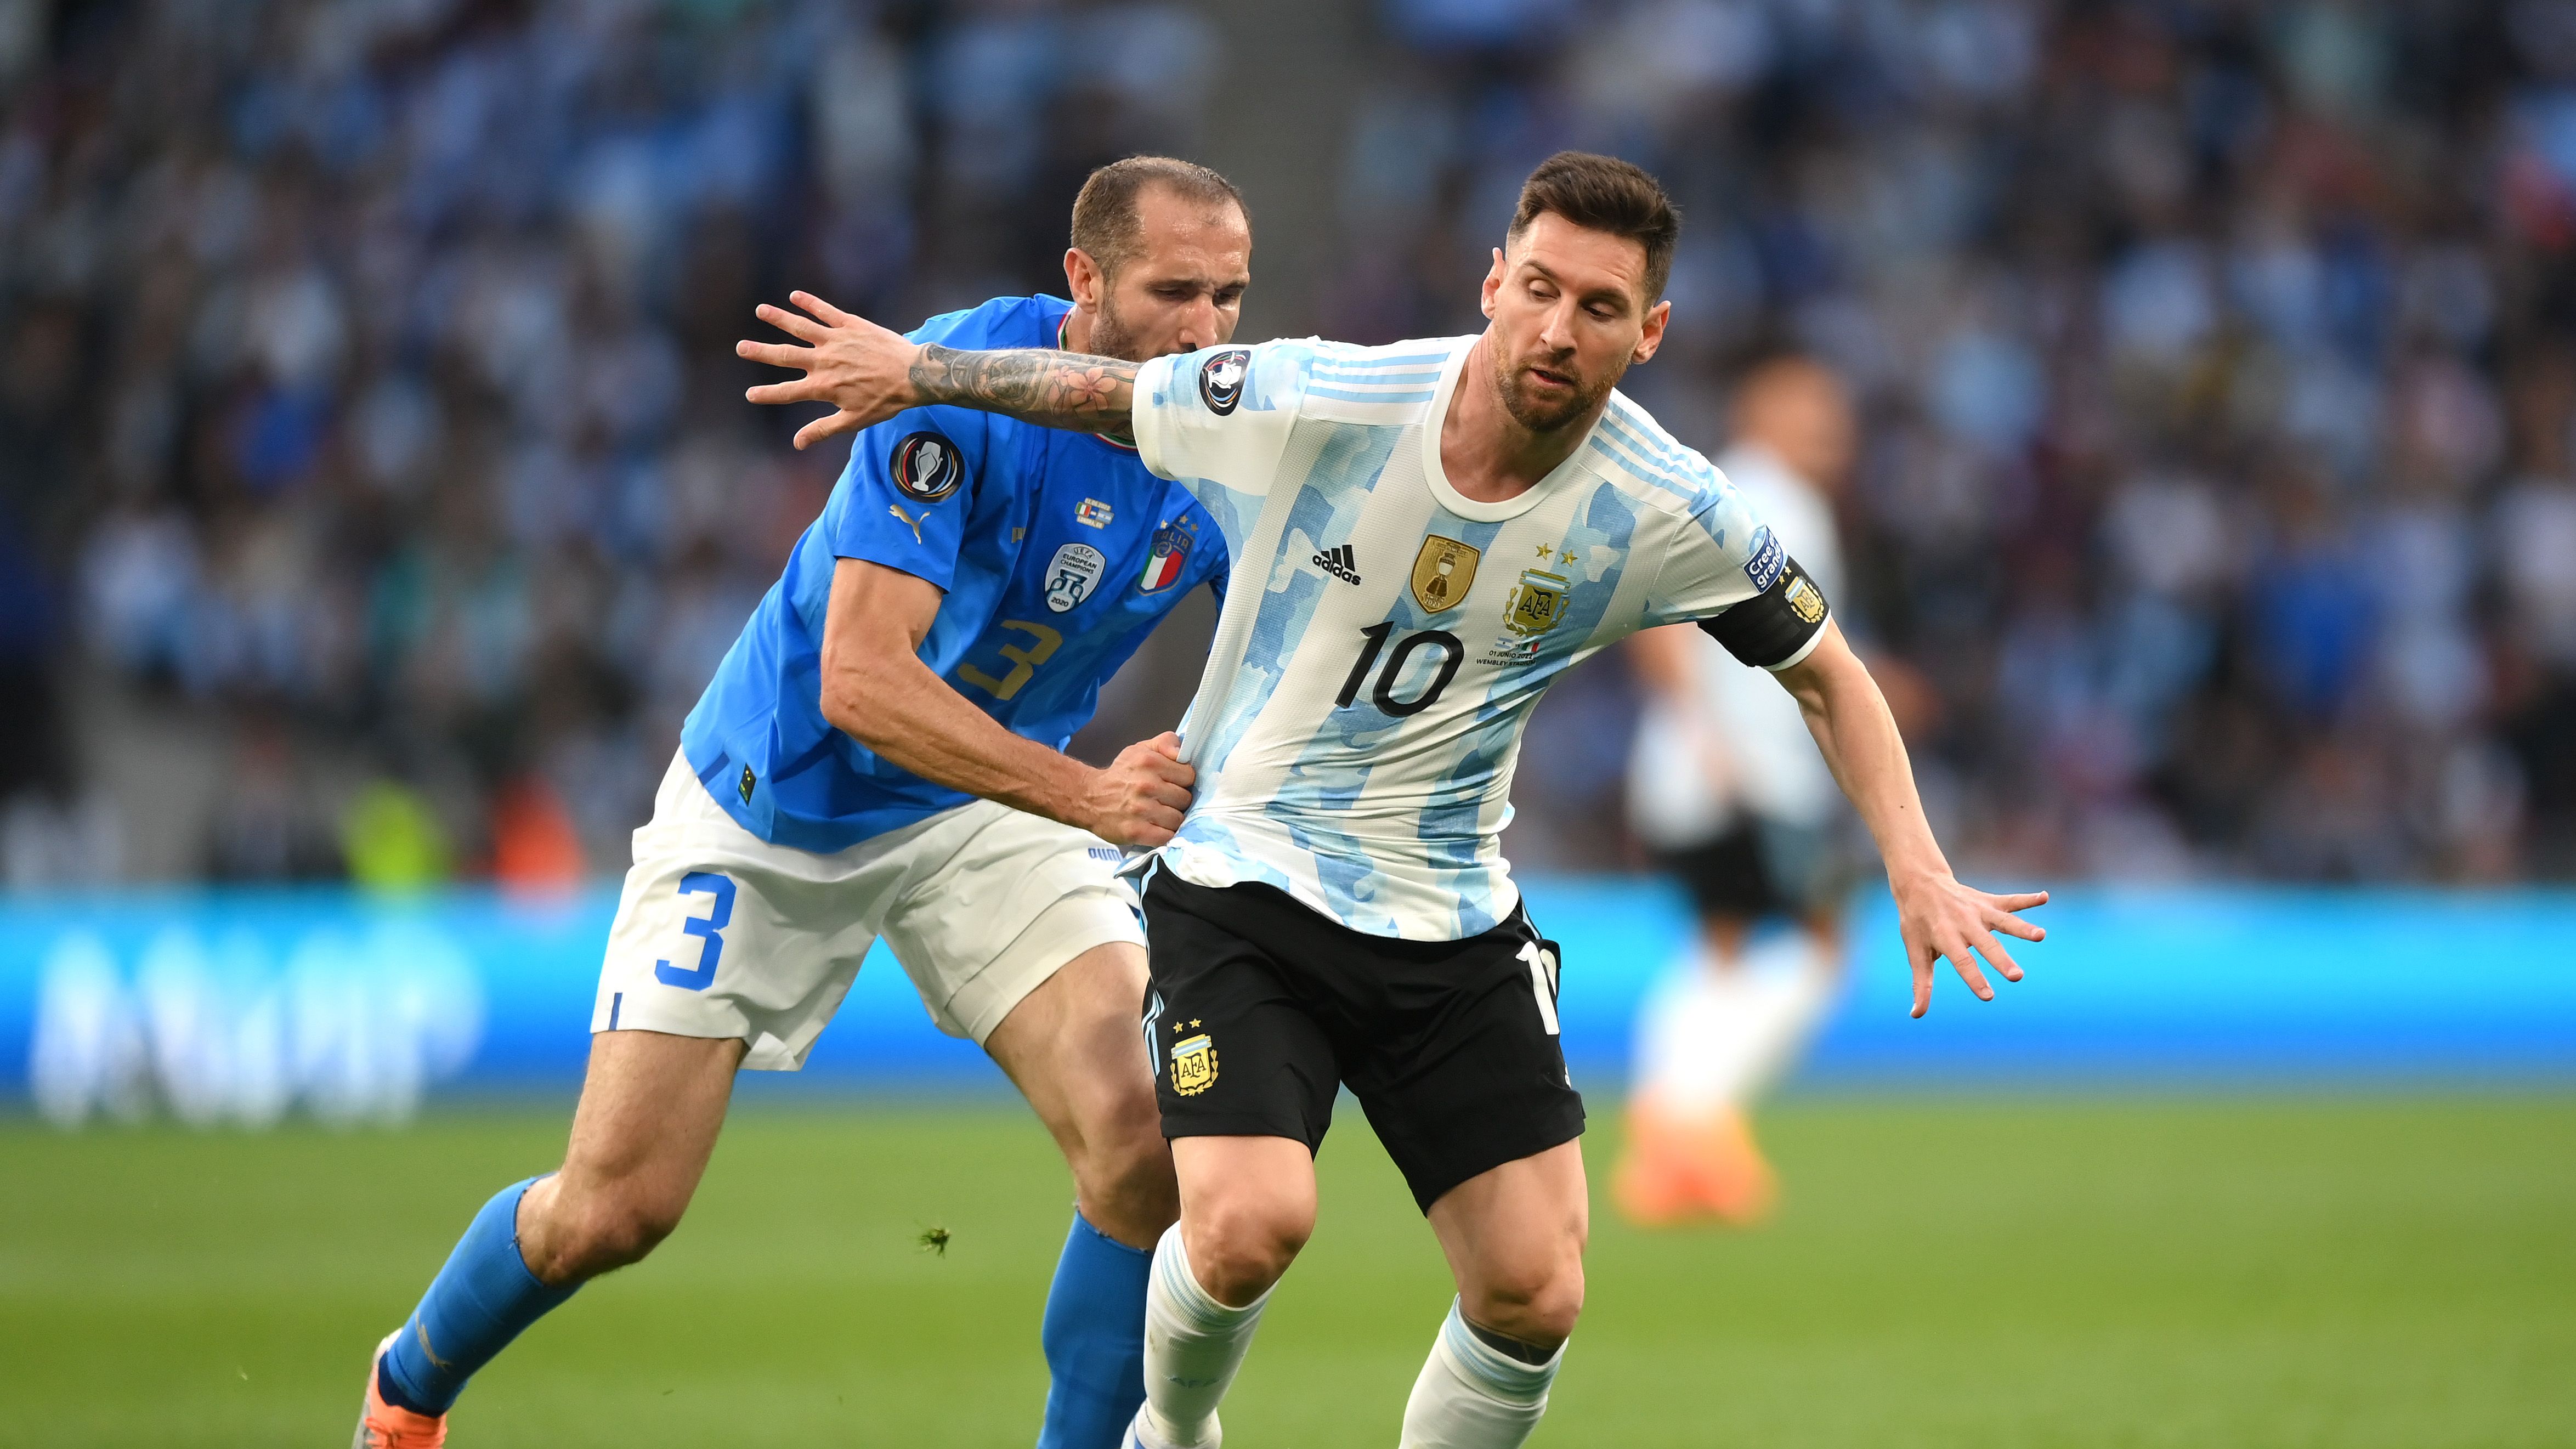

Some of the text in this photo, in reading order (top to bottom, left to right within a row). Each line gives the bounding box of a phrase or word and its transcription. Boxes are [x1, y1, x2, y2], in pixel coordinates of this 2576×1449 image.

[1061, 559, 1095, 574] CHAMPIONS
[1063, 553, 1097, 569] EUROPEAN
[1074, 548, 1093, 559] UEFA
[1749, 546, 1773, 575] Cree
[1757, 543, 1781, 588] grande
[1312, 555, 1361, 586] adidas
[1051, 597, 1069, 607] 2020
[1519, 586, 1553, 620] AFA
[1796, 589, 1815, 612] AFA
[956, 620, 1063, 701] 3
[1334, 620, 1464, 718] 10
[654, 871, 737, 992] 3
[1181, 1052, 1207, 1078] AFA
